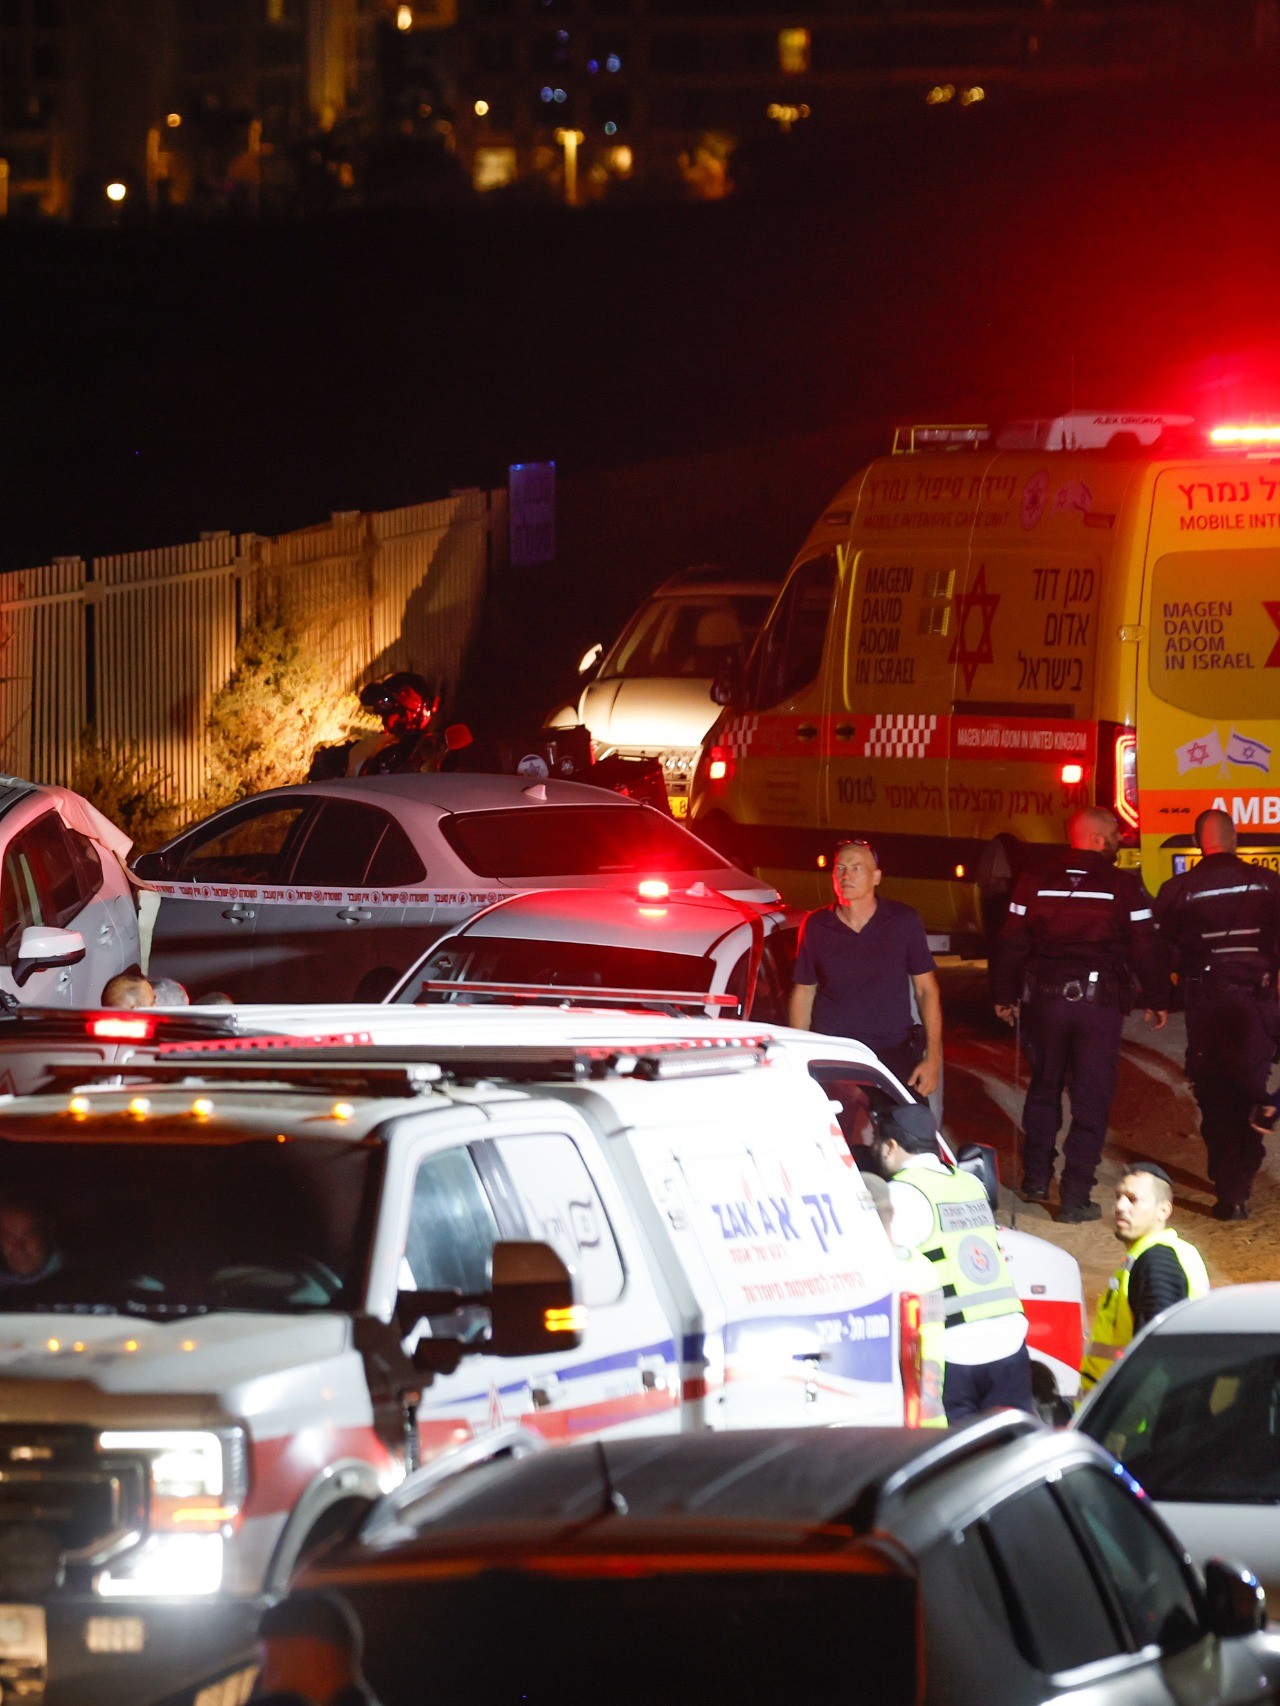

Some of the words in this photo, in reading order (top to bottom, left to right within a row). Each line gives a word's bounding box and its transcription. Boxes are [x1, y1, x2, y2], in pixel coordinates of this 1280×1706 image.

[1178, 481, 1251, 510] נמרץ
[1180, 514, 1245, 530] MOBILE
[1249, 513, 1280, 528] INT
[865, 567, 915, 594] MAGEN
[1032, 568, 1061, 601] דוד
[1064, 568, 1095, 608] מגן
[861, 599, 903, 624] DAVID
[1163, 602, 1233, 618] MAGEN
[858, 627, 900, 654] ADOM
[1043, 613, 1090, 646] אדום
[1164, 619, 1224, 635] DAVID
[1165, 636, 1225, 652] ADOM
[855, 658, 869, 684] IN
[873, 657, 916, 684] ISRAEL
[1017, 650, 1083, 691] בישראל
[1165, 655, 1185, 670] IN
[1193, 653, 1255, 669] ISRAEL
[957, 728, 980, 746] MAGEN
[981, 729, 1000, 747] DAVID
[1000, 730, 1020, 748] ADOM
